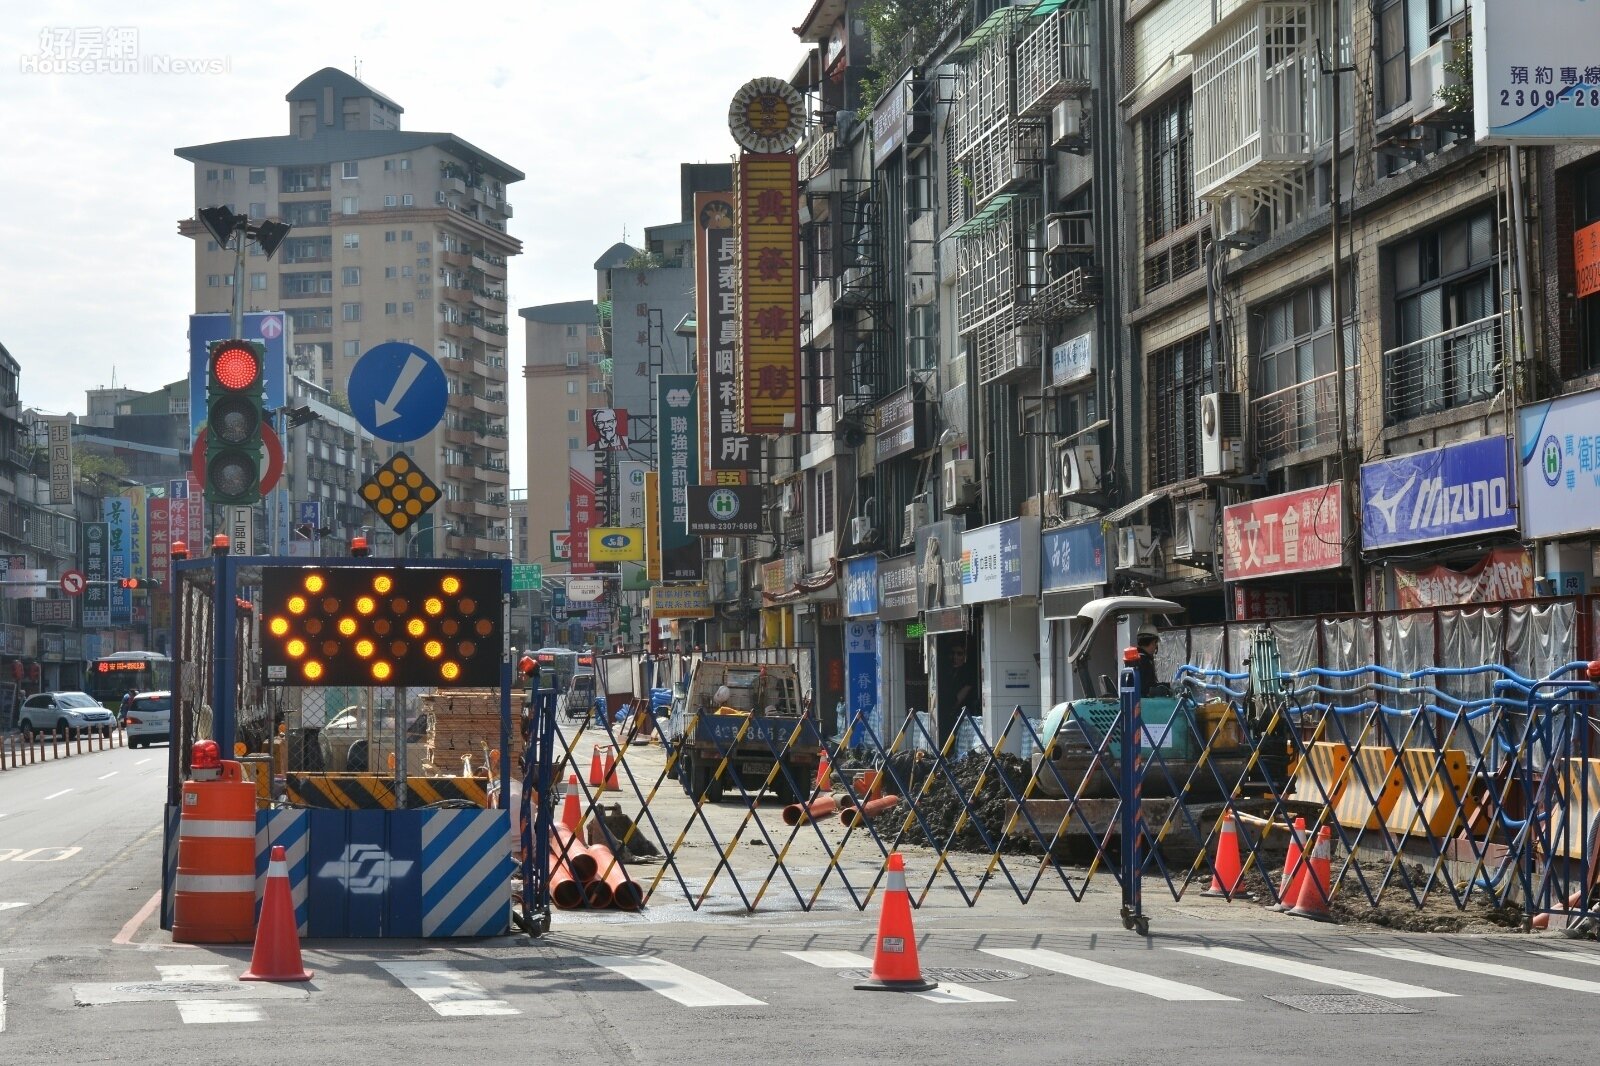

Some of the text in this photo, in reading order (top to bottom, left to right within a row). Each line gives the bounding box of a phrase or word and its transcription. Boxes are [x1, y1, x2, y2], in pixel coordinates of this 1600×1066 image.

[51, 425, 69, 500] 非凡樂器
[670, 416, 688, 523] 聯強資訊聯盟
[189, 491, 201, 542] 日立家電
[1226, 505, 1299, 571] 藝文工會
